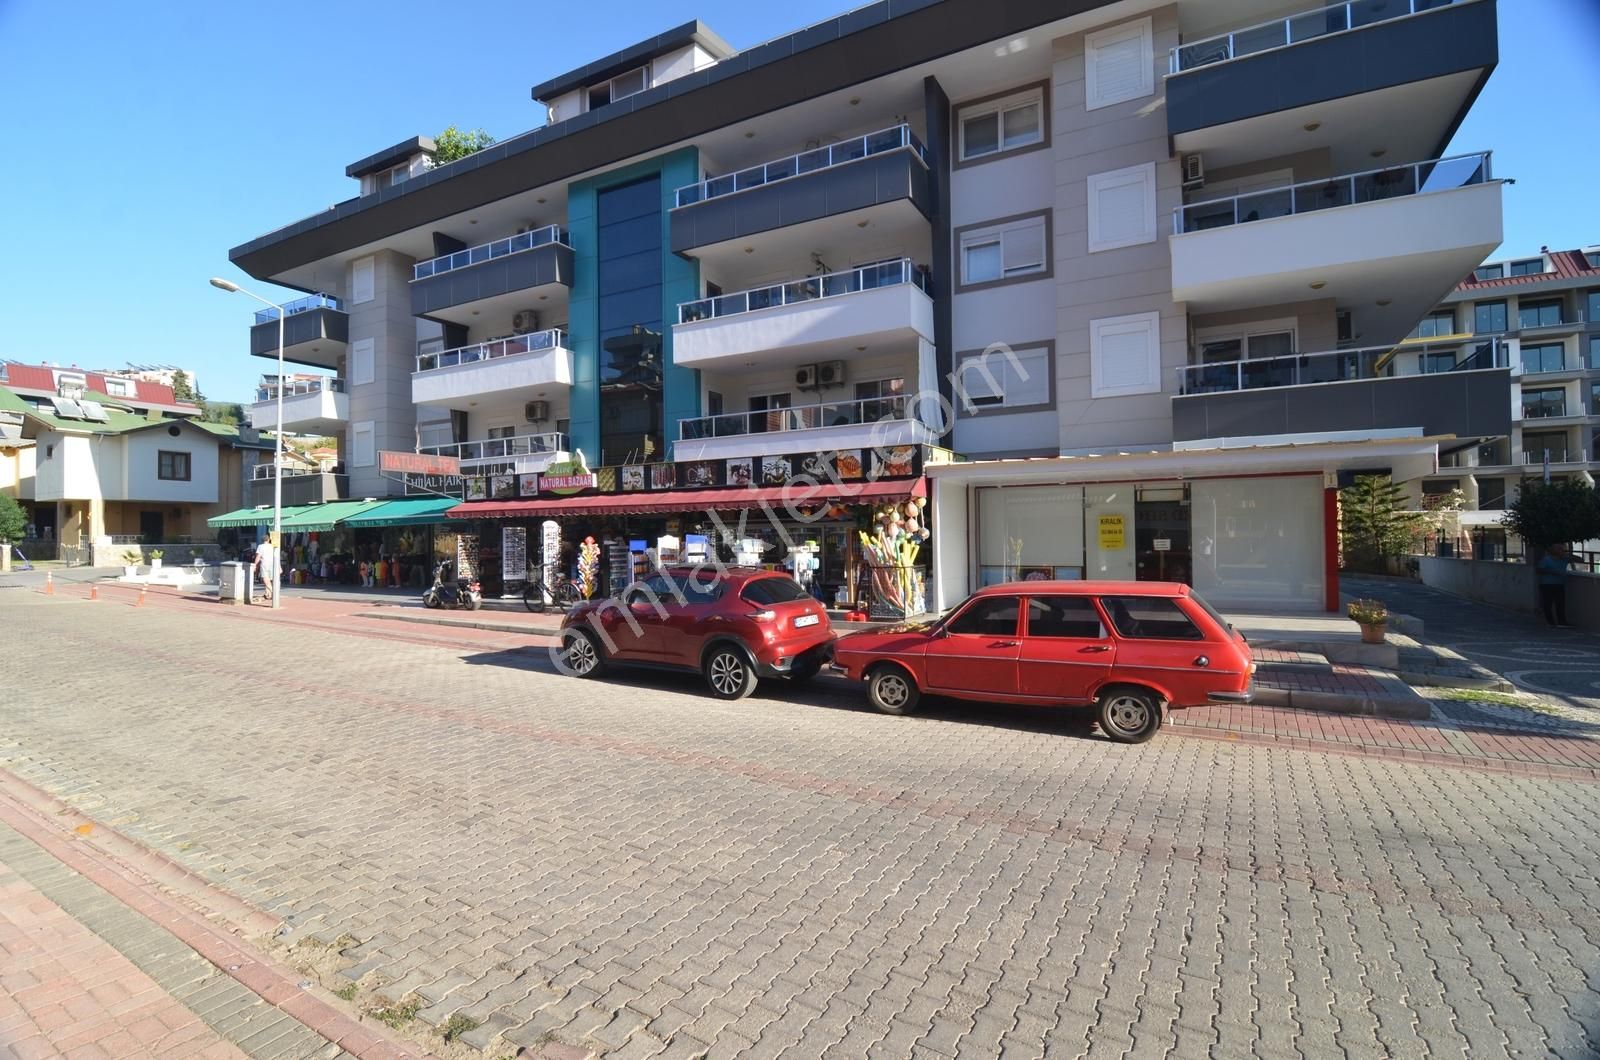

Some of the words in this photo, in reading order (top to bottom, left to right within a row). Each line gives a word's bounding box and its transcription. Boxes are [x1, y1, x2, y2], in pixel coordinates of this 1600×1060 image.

[383, 453, 432, 472] NATURAL
[438, 457, 457, 474] TEA
[540, 477, 567, 489] NATURAL
[568, 474, 592, 487] BAZAAR
